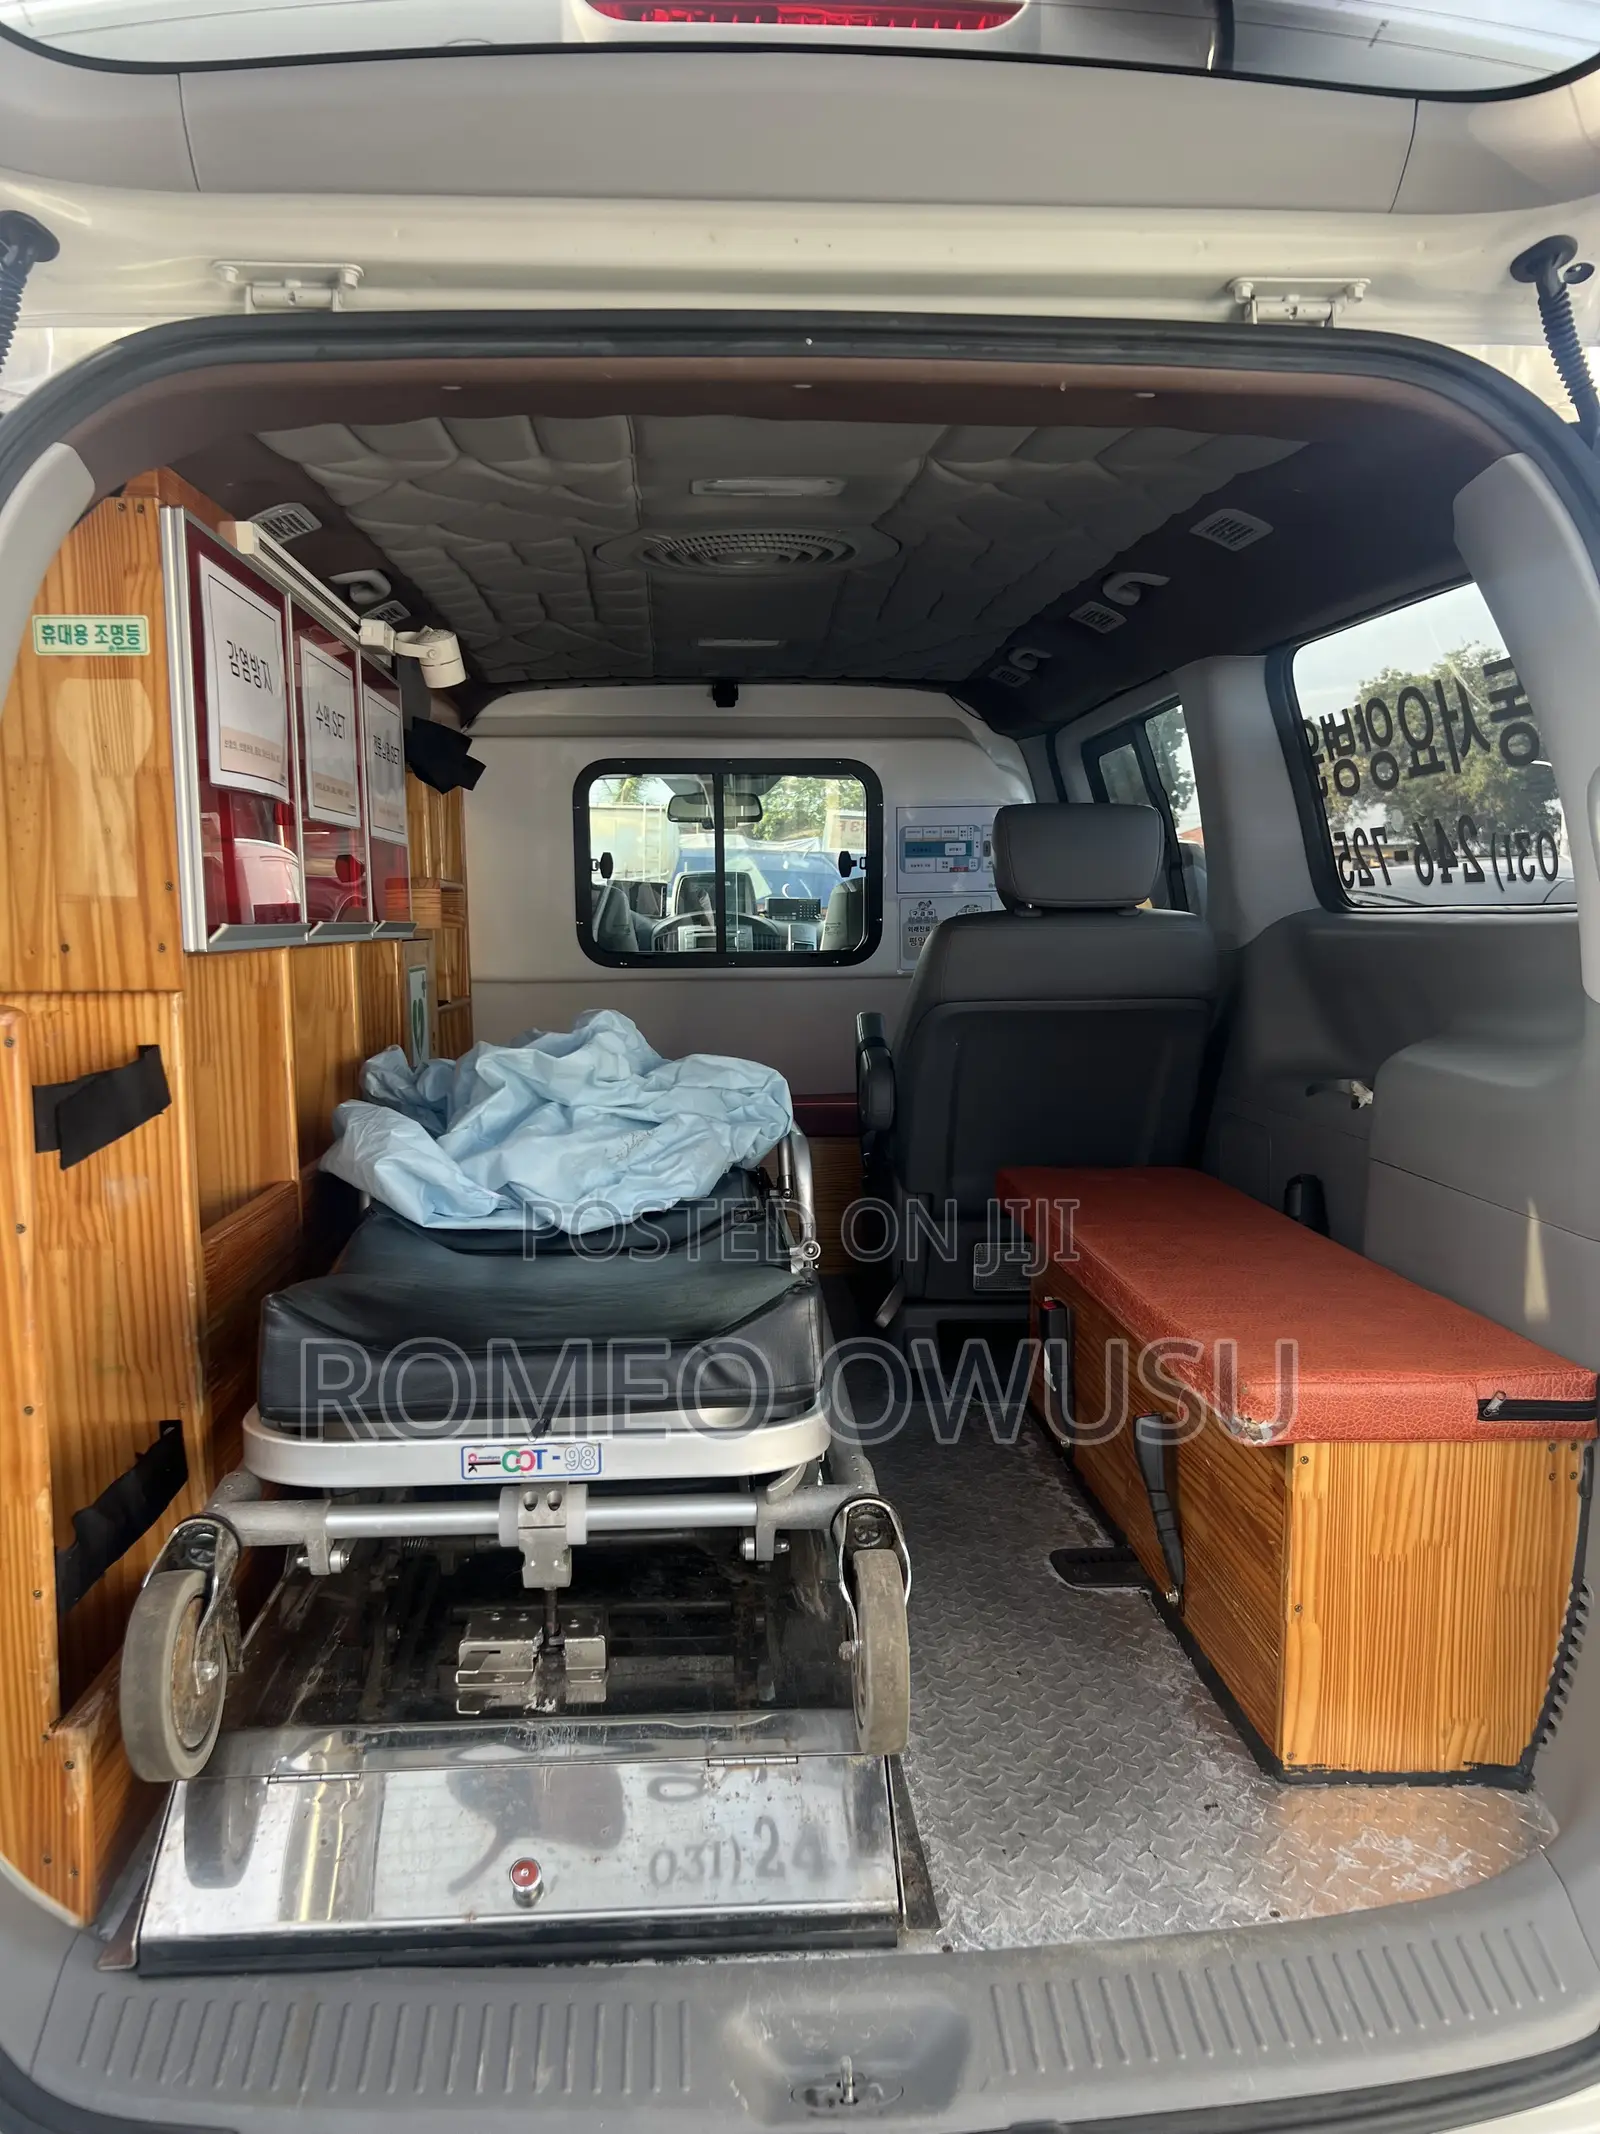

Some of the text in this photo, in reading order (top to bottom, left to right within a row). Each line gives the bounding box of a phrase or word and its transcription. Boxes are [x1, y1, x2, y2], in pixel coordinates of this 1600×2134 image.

[42, 624, 141, 646] 휴대용 조명등
[226, 639, 273, 695] 감염방지
[315, 701, 346, 740] 수액 SET
